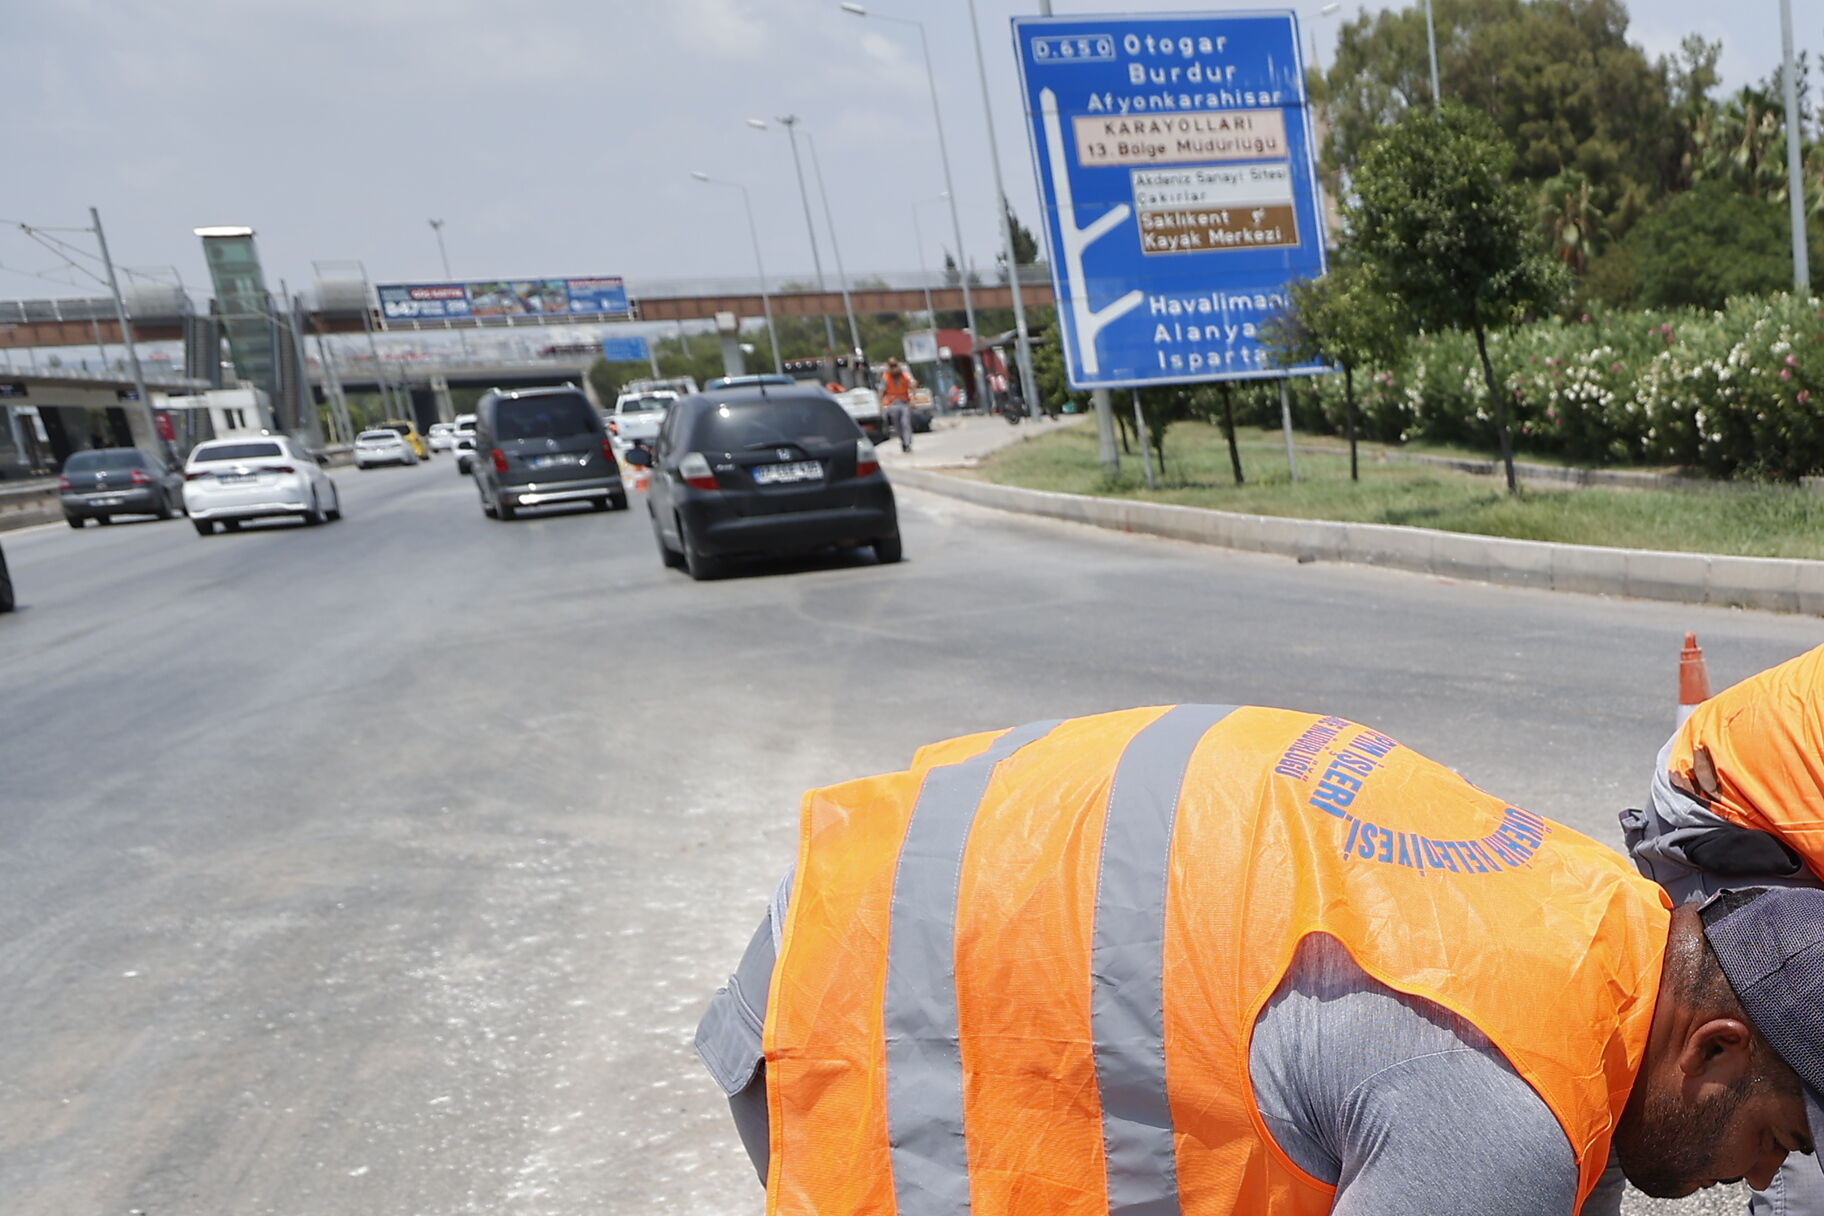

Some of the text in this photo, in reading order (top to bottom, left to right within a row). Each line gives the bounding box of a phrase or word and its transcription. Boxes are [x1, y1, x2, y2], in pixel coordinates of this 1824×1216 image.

[1035, 33, 1227, 59] D.650 Otogar
[1128, 61, 1237, 85] Burdur
[1087, 89, 1282, 115] Afyonkarahisar
[1104, 116, 1254, 137] KARAYOLLARI
[1087, 143, 1112, 159] 13.
[1118, 140, 1166, 159] Bölge
[1135, 172, 1191, 187] Akdeniz
[1196, 169, 1245, 186] Sanayi
[1140, 209, 1230, 230] Saklıkent
[1143, 226, 1282, 252] Kayak Merkezi
[1153, 321, 1258, 350] Alanya
[1158, 346, 1268, 372] Isparta
[1308, 749, 1385, 821] İŞLERİ
[1343, 818, 1504, 877] BELEDİYESİ
